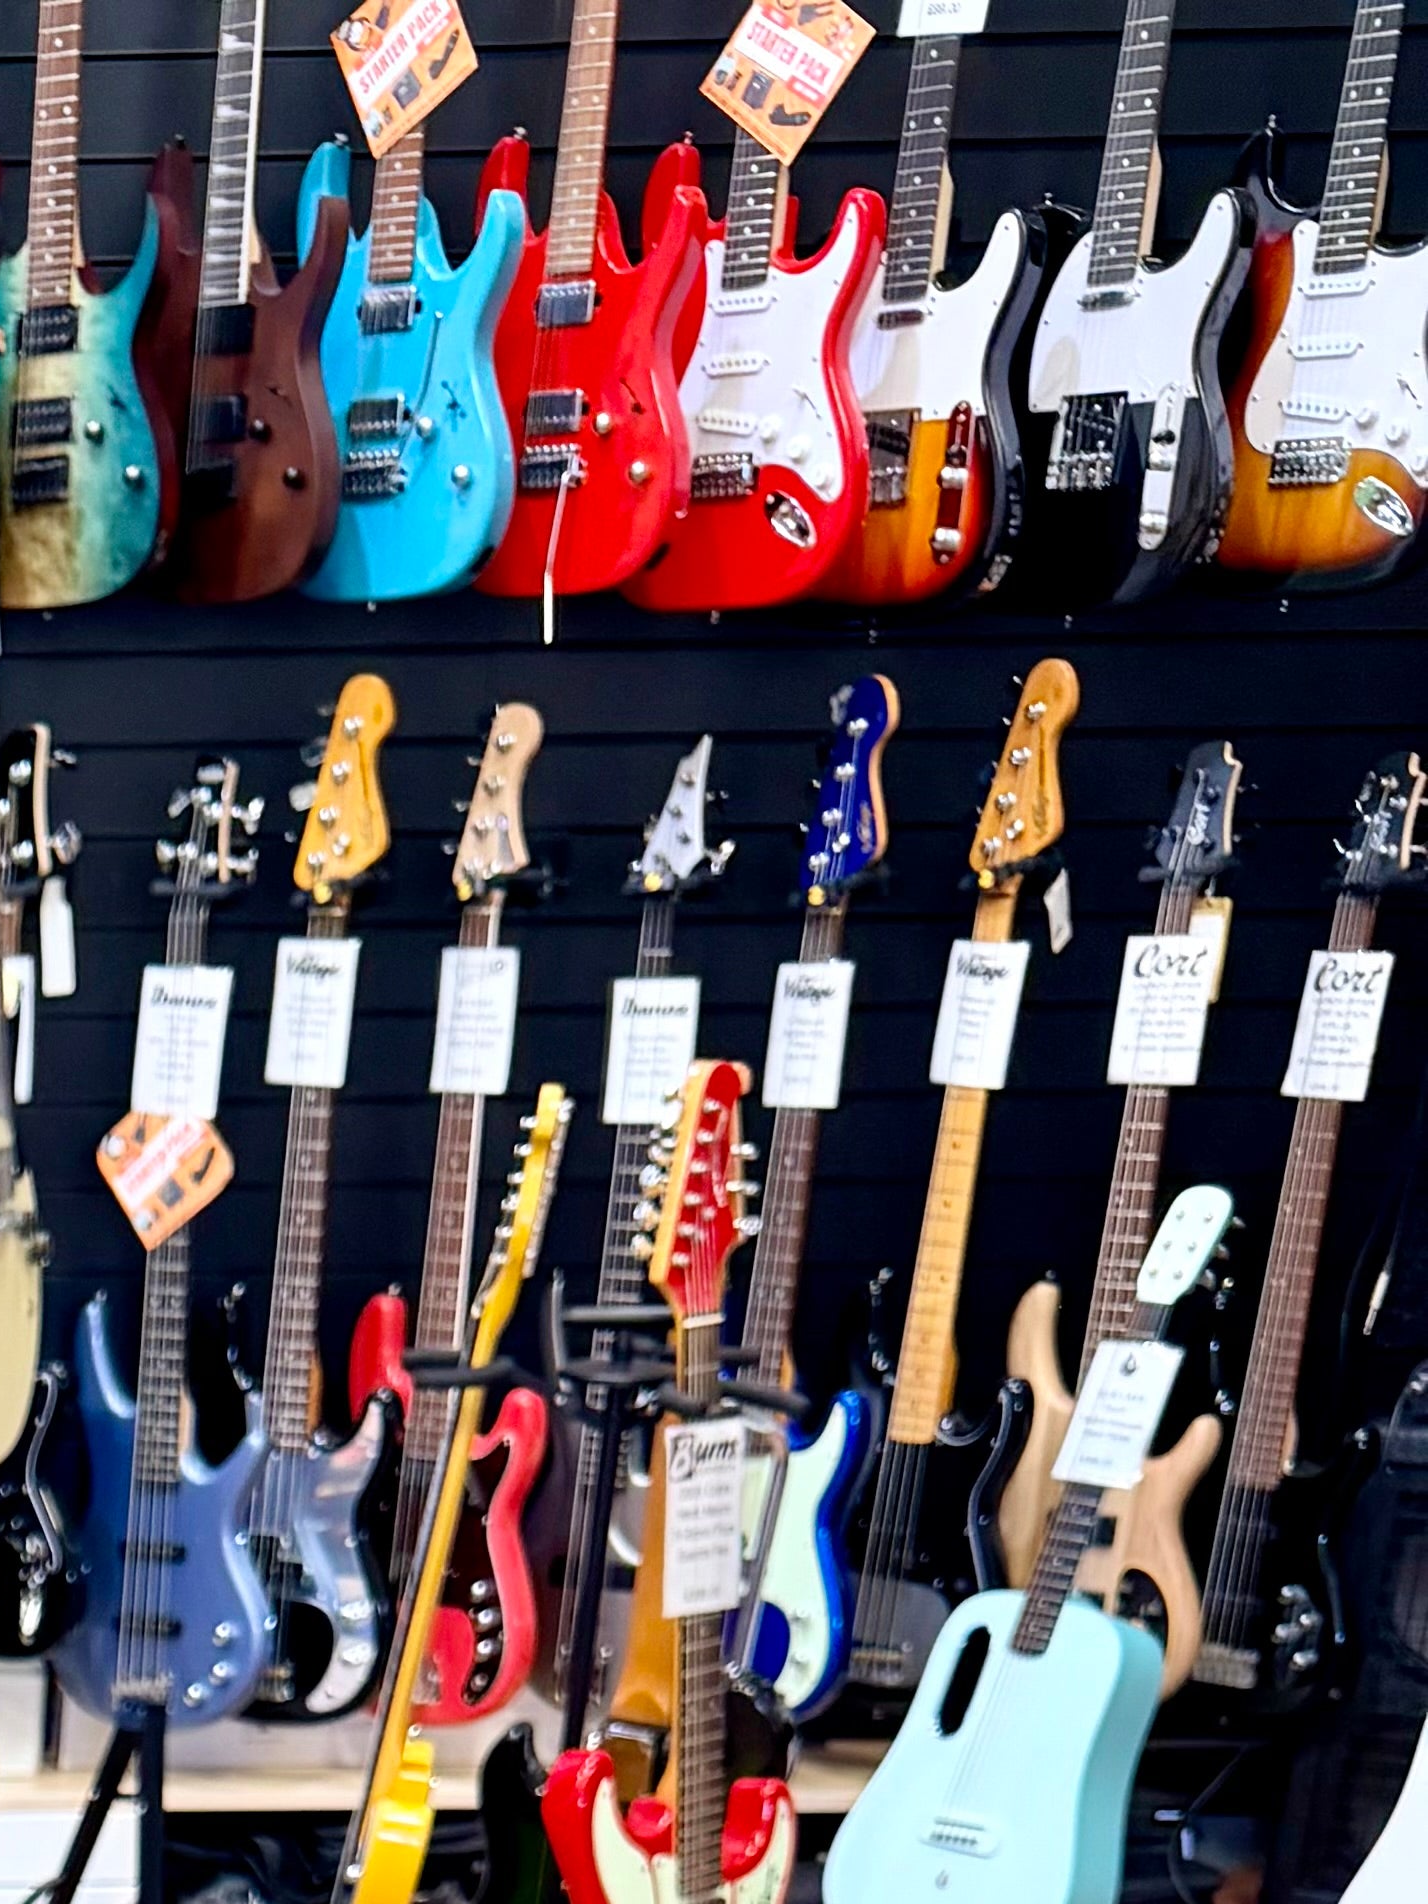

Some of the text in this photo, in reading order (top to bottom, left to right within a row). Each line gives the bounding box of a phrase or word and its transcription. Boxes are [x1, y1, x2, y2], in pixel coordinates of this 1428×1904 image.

[1133, 943, 1208, 979] Cort
[1313, 958, 1384, 993] Cort
[669, 1434, 739, 1482] Burns
